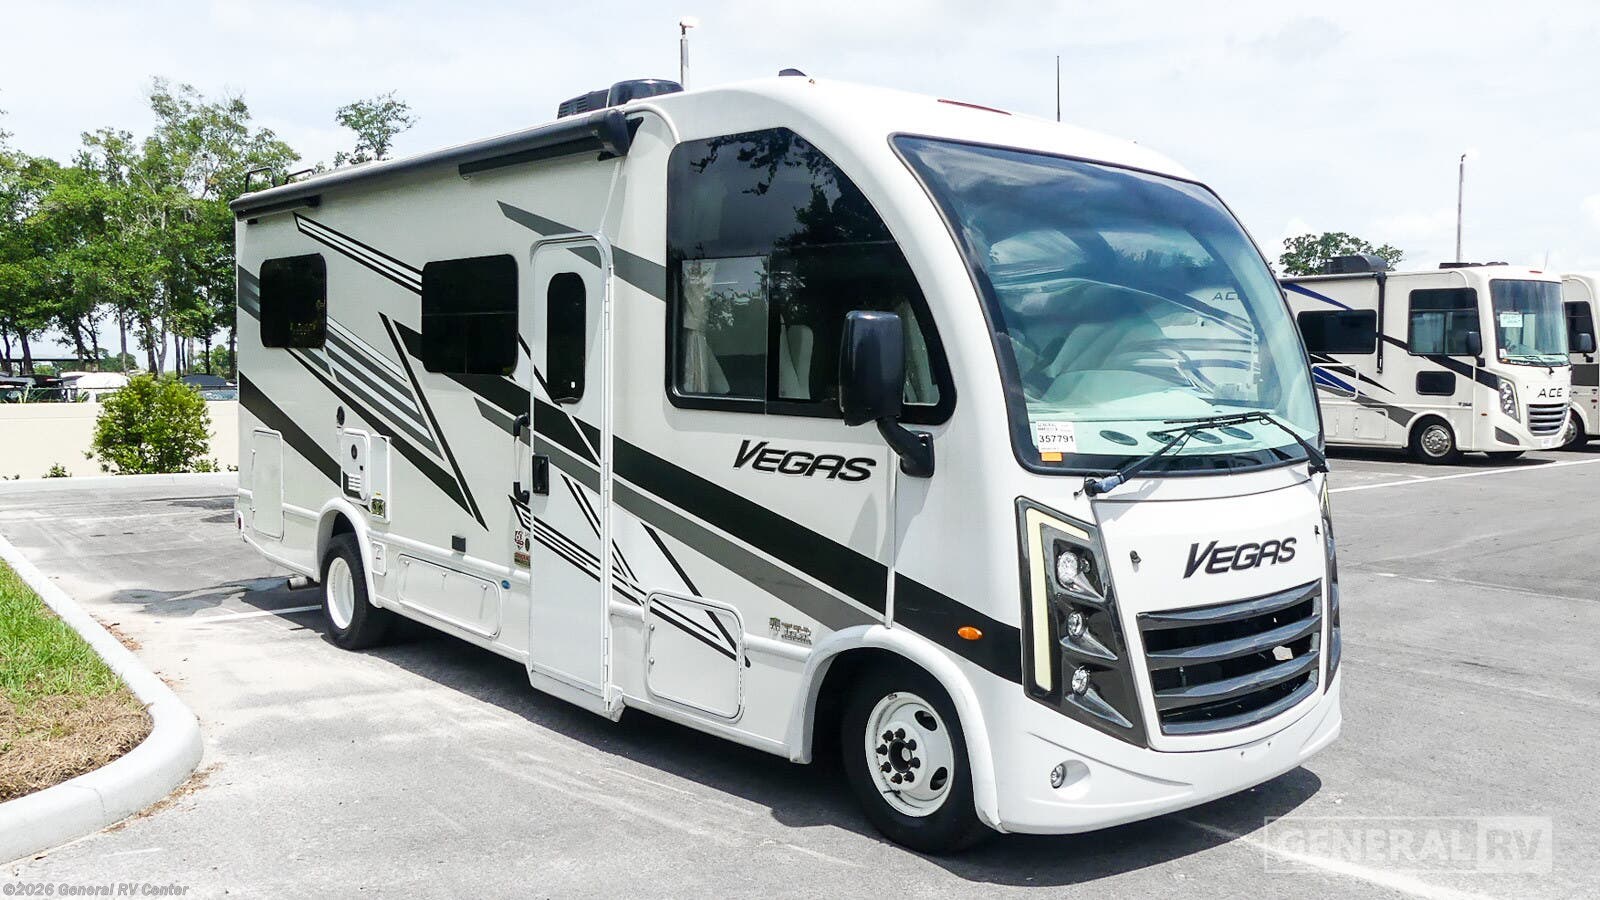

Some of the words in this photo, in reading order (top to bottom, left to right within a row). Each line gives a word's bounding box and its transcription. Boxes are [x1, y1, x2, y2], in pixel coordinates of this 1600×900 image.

[1537, 387, 1563, 398] ACE
[1039, 434, 1074, 443] 357791
[733, 439, 877, 482] VEGAS
[1183, 537, 1297, 579] VEGAS
